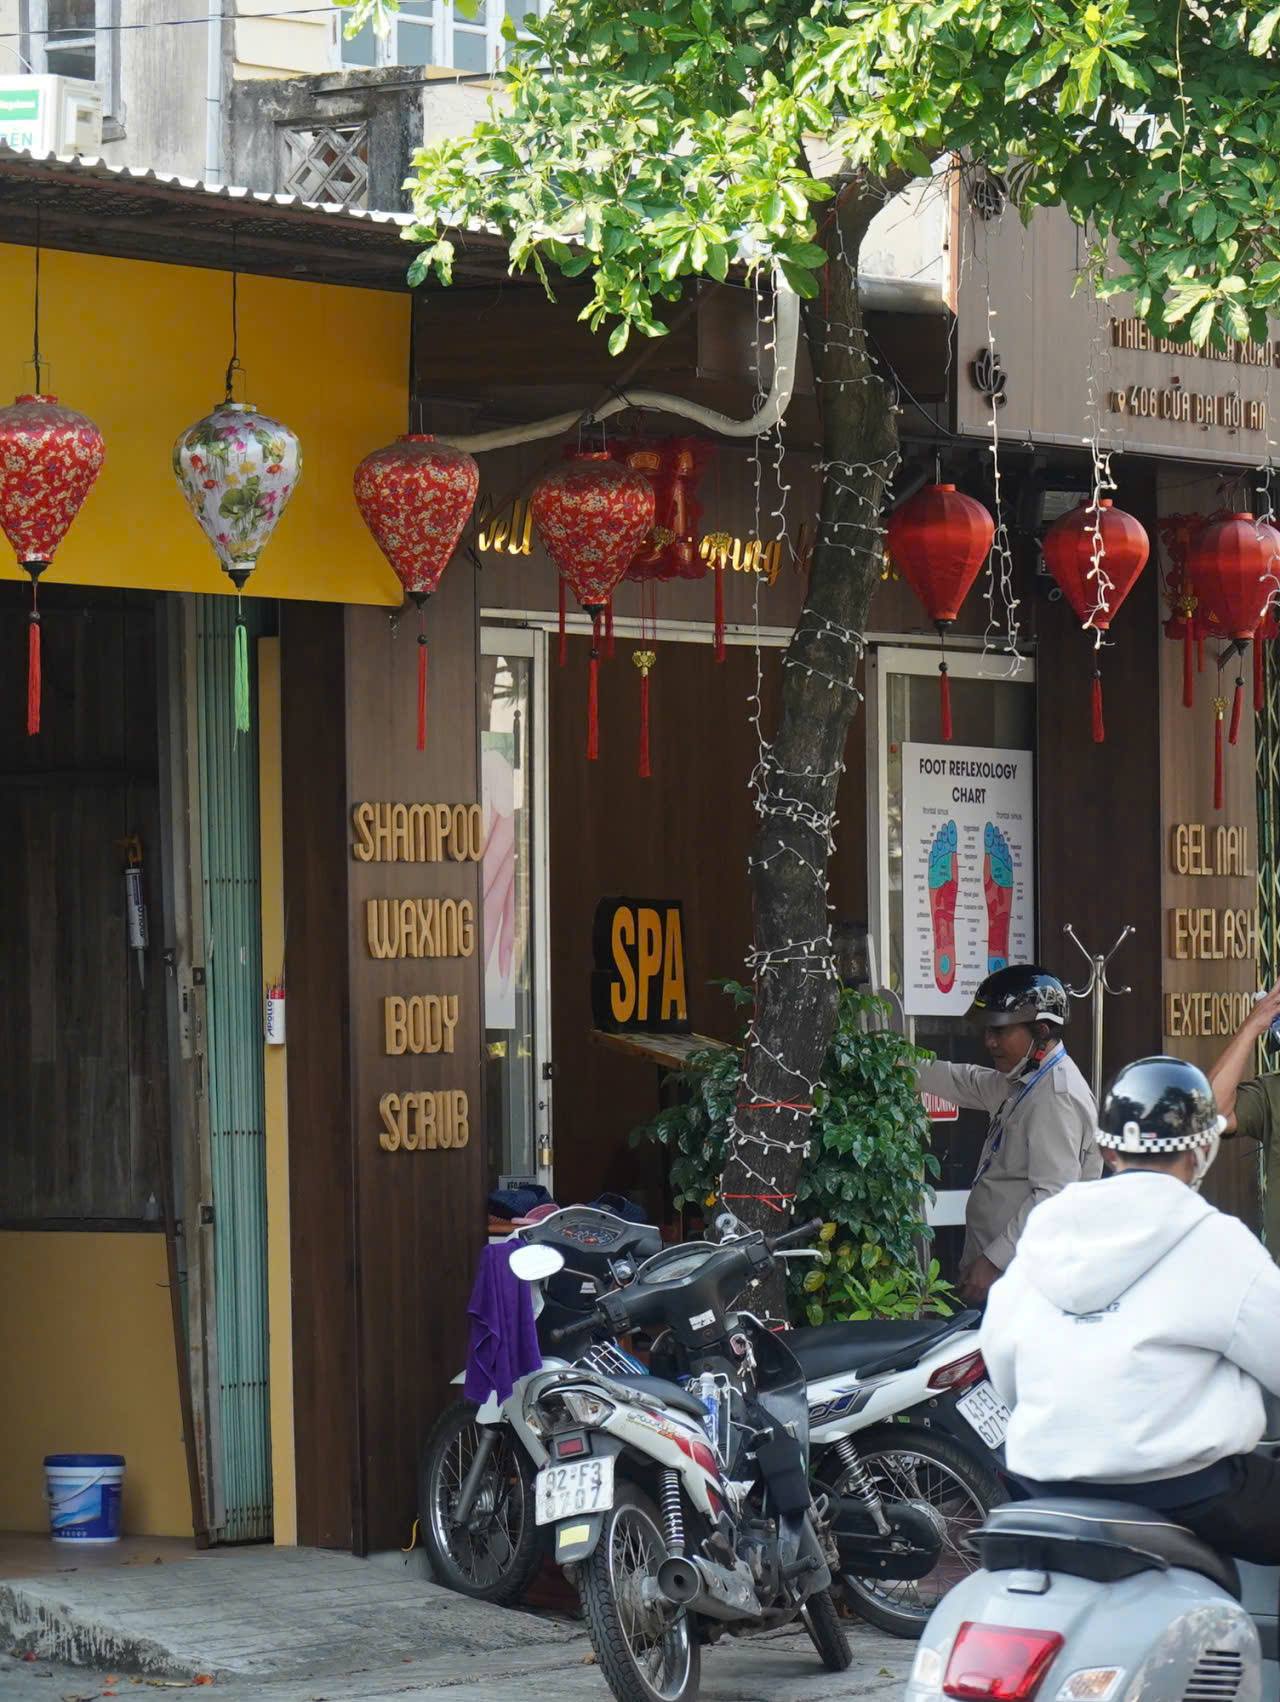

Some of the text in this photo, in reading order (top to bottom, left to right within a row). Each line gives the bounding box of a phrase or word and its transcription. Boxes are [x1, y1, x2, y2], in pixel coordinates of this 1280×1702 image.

[1131, 386, 1158, 417] 406
[1250, 401, 1266, 431] AN
[920, 759, 1017, 779] FOOT REFLEXOLOGY
[952, 787, 986, 804] CHART
[353, 802, 483, 862] SHAMPOO
[1174, 823, 1255, 877] GEL NAIL
[367, 899, 474, 959] WAXING
[1173, 908, 1258, 960] EYELASH
[611, 905, 688, 1022] SPA
[264, 1000, 273, 1036] APOLLO
[385, 995, 459, 1055] BODY
[379, 1090, 469, 1151] SCRUB
